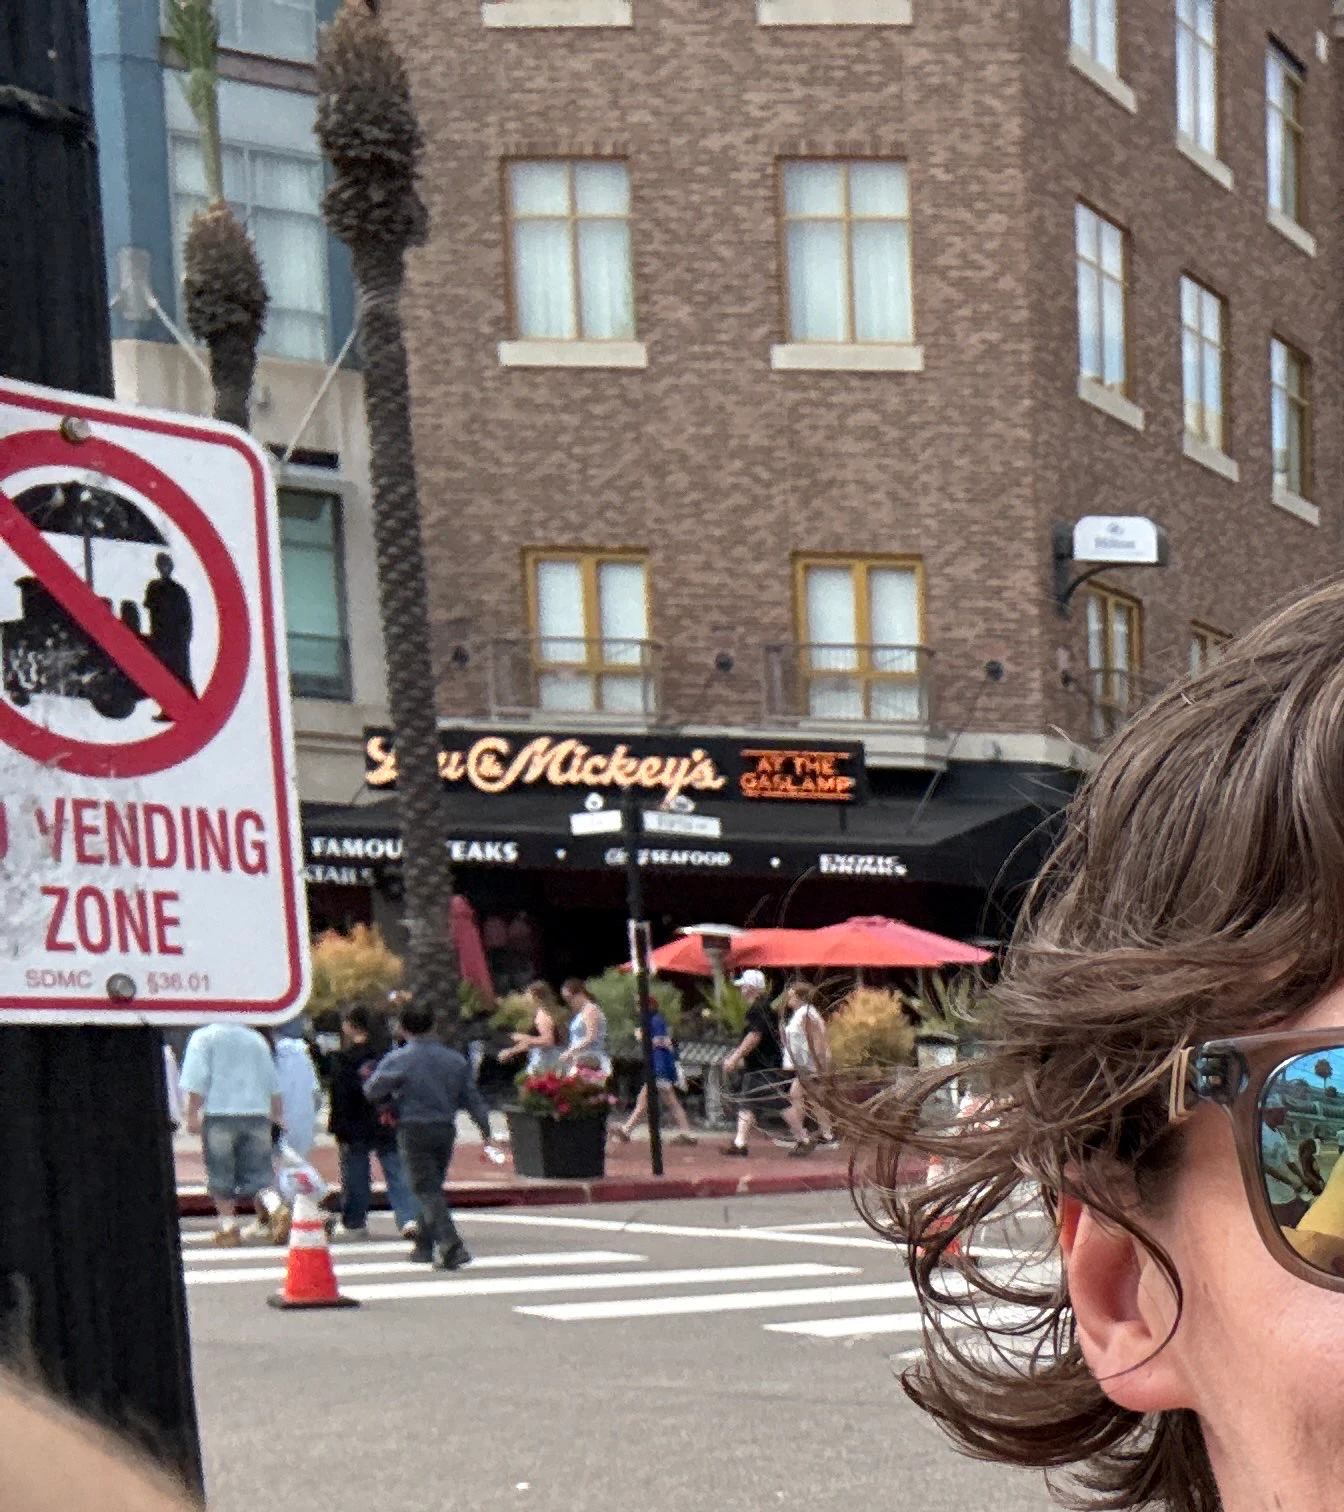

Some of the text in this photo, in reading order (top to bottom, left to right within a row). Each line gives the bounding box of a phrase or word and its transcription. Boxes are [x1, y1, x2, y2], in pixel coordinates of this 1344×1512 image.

[366, 736, 466, 785] Lu
[498, 736, 726, 809] Mickey's
[757, 756, 838, 776] AT THE
[34, 797, 268, 876] VENDING
[311, 836, 404, 861] FAMOU
[40, 884, 184, 956] ZONE
[25, 969, 93, 989] SDMC
